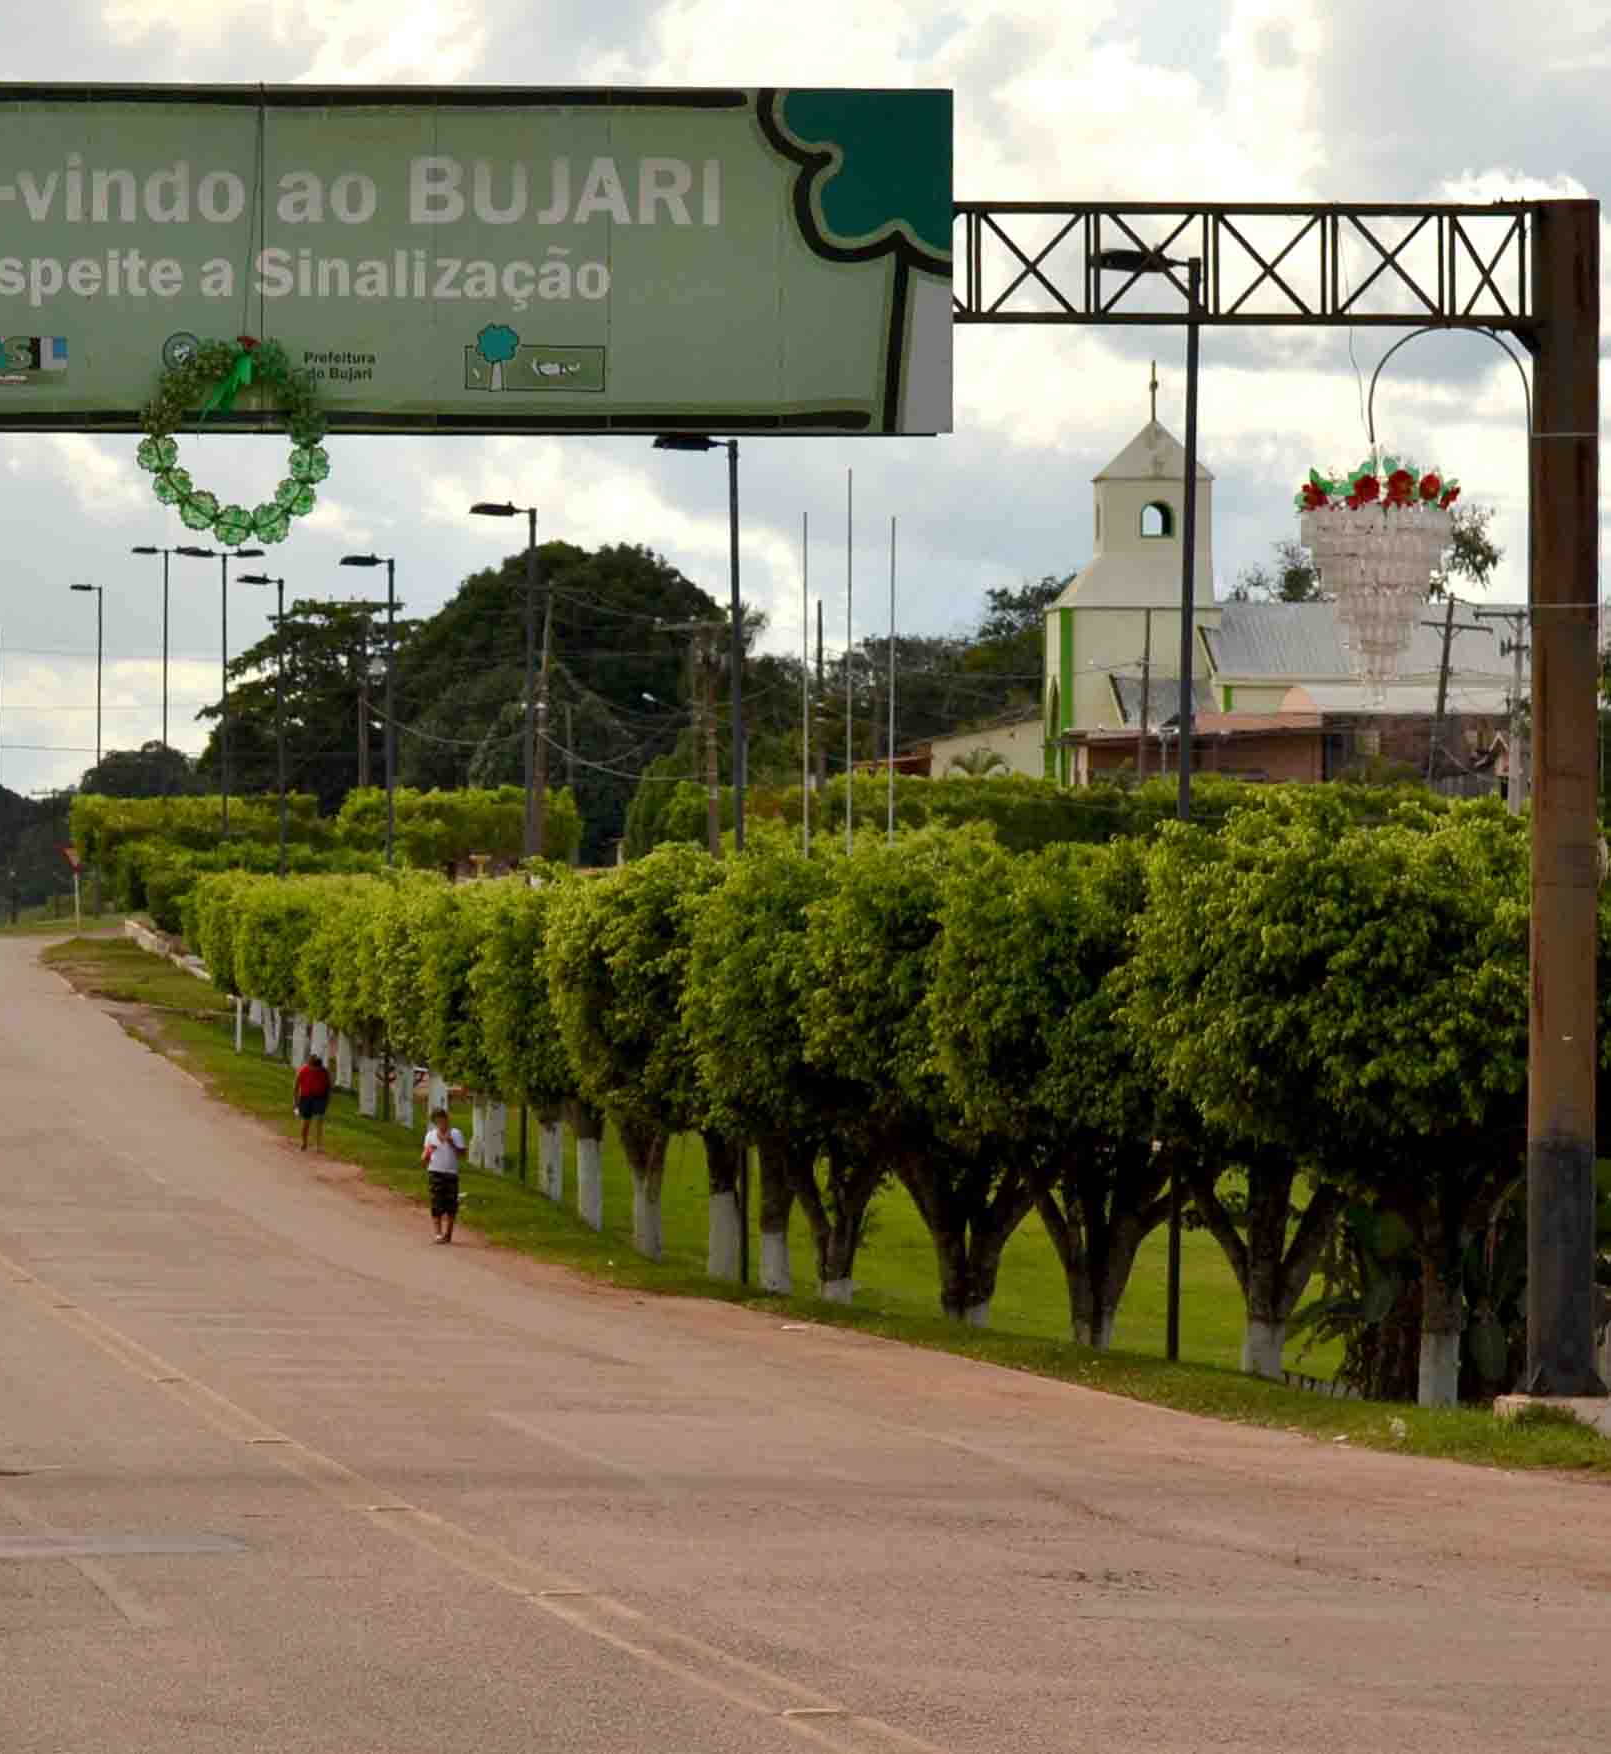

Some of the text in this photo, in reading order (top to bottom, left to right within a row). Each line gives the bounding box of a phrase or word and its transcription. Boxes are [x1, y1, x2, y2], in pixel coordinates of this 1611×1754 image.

[277, 169, 376, 225] ao
[409, 156, 722, 226] BUJARI
[201, 256, 235, 297] a
[254, 245, 612, 311] Sinalização
[304, 351, 376, 365] Prefeitura
[329, 367, 373, 383] Bujari
